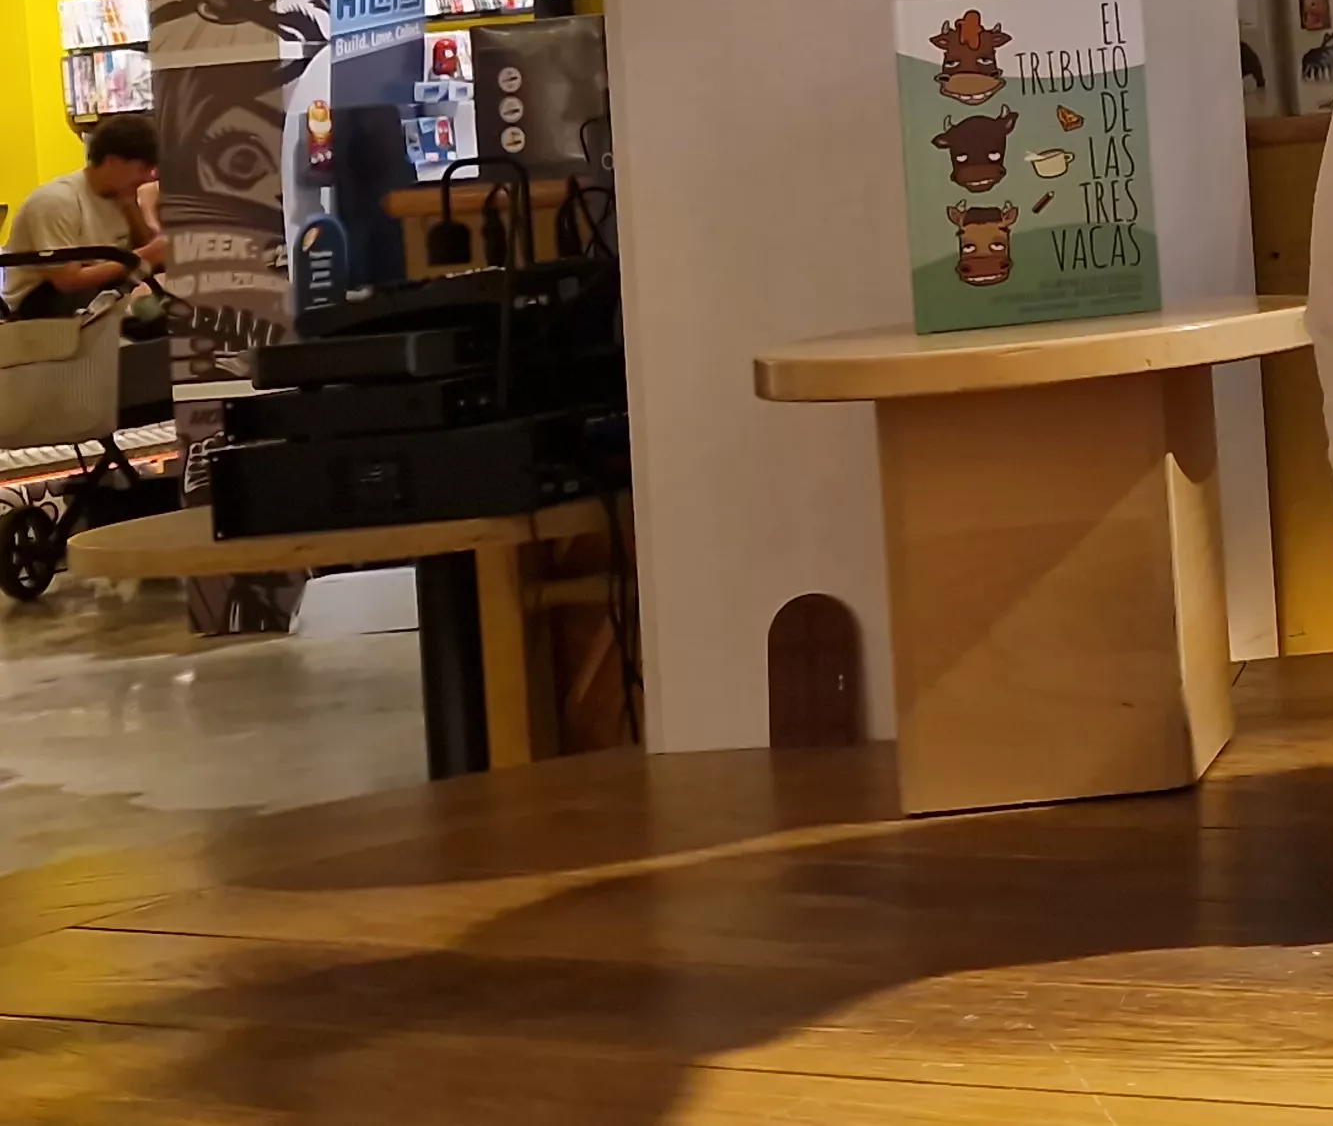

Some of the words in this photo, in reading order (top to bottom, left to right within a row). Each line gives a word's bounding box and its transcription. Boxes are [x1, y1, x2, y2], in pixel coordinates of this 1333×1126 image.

[1100, 1, 1128, 46] EL
[1014, 45, 1130, 96] TRIBUTO
[1101, 89, 1134, 134] DE
[1088, 133, 1136, 181] LAS
[1079, 178, 1139, 224] TRES
[1051, 223, 1142, 271] VACAS
